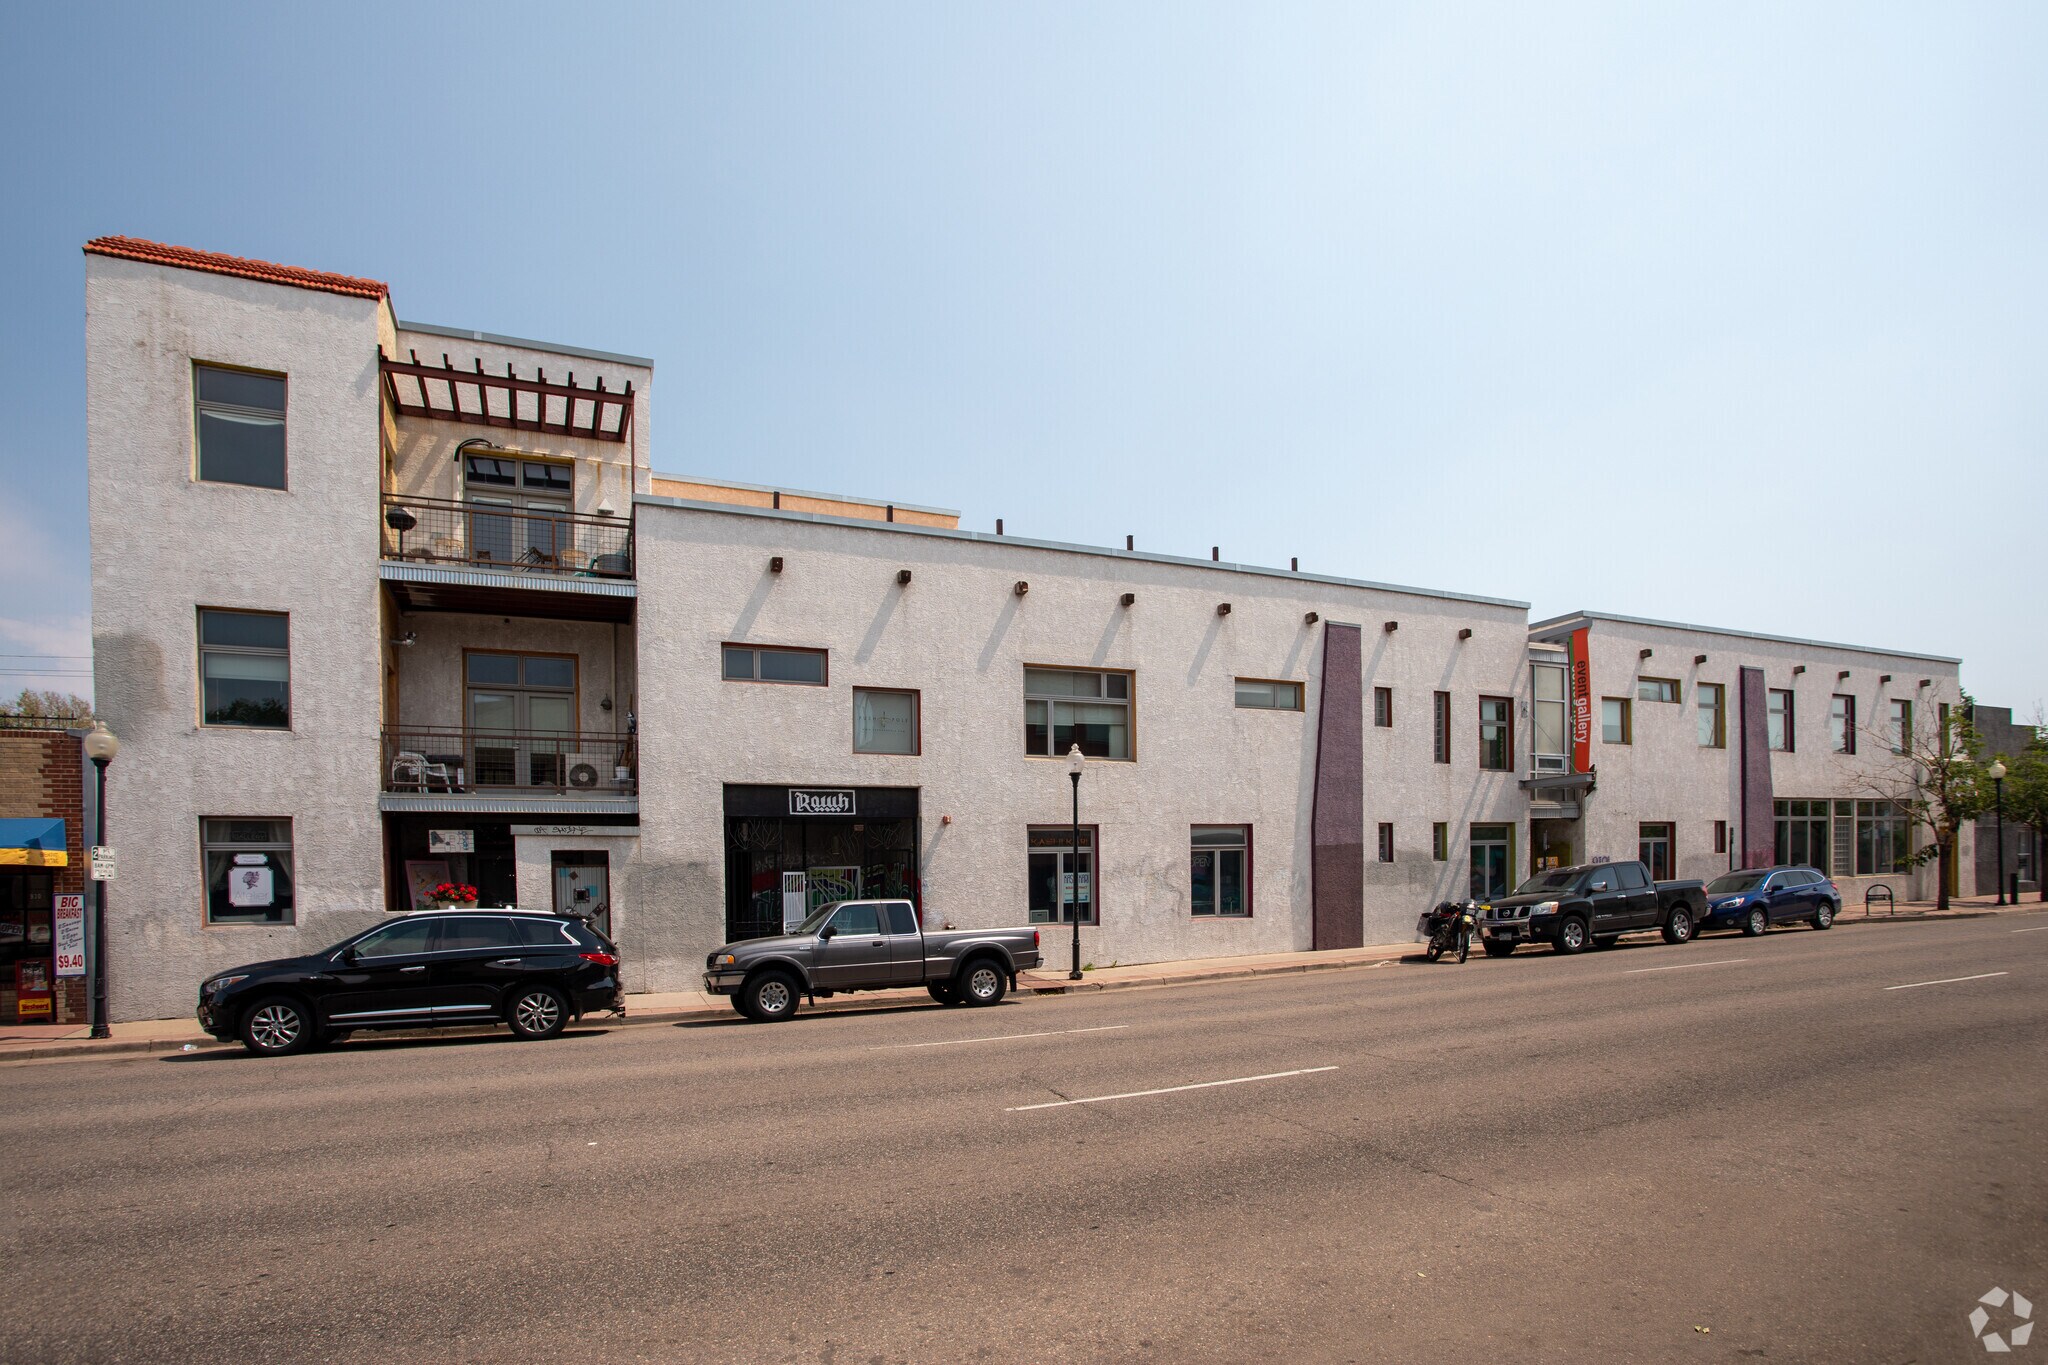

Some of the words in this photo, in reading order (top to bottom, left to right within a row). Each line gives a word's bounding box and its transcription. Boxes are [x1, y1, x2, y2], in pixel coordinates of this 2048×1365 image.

[61, 896, 78, 907] BIG
[57, 907, 82, 919] BREAKFAST
[58, 954, 83, 968] $9.40
